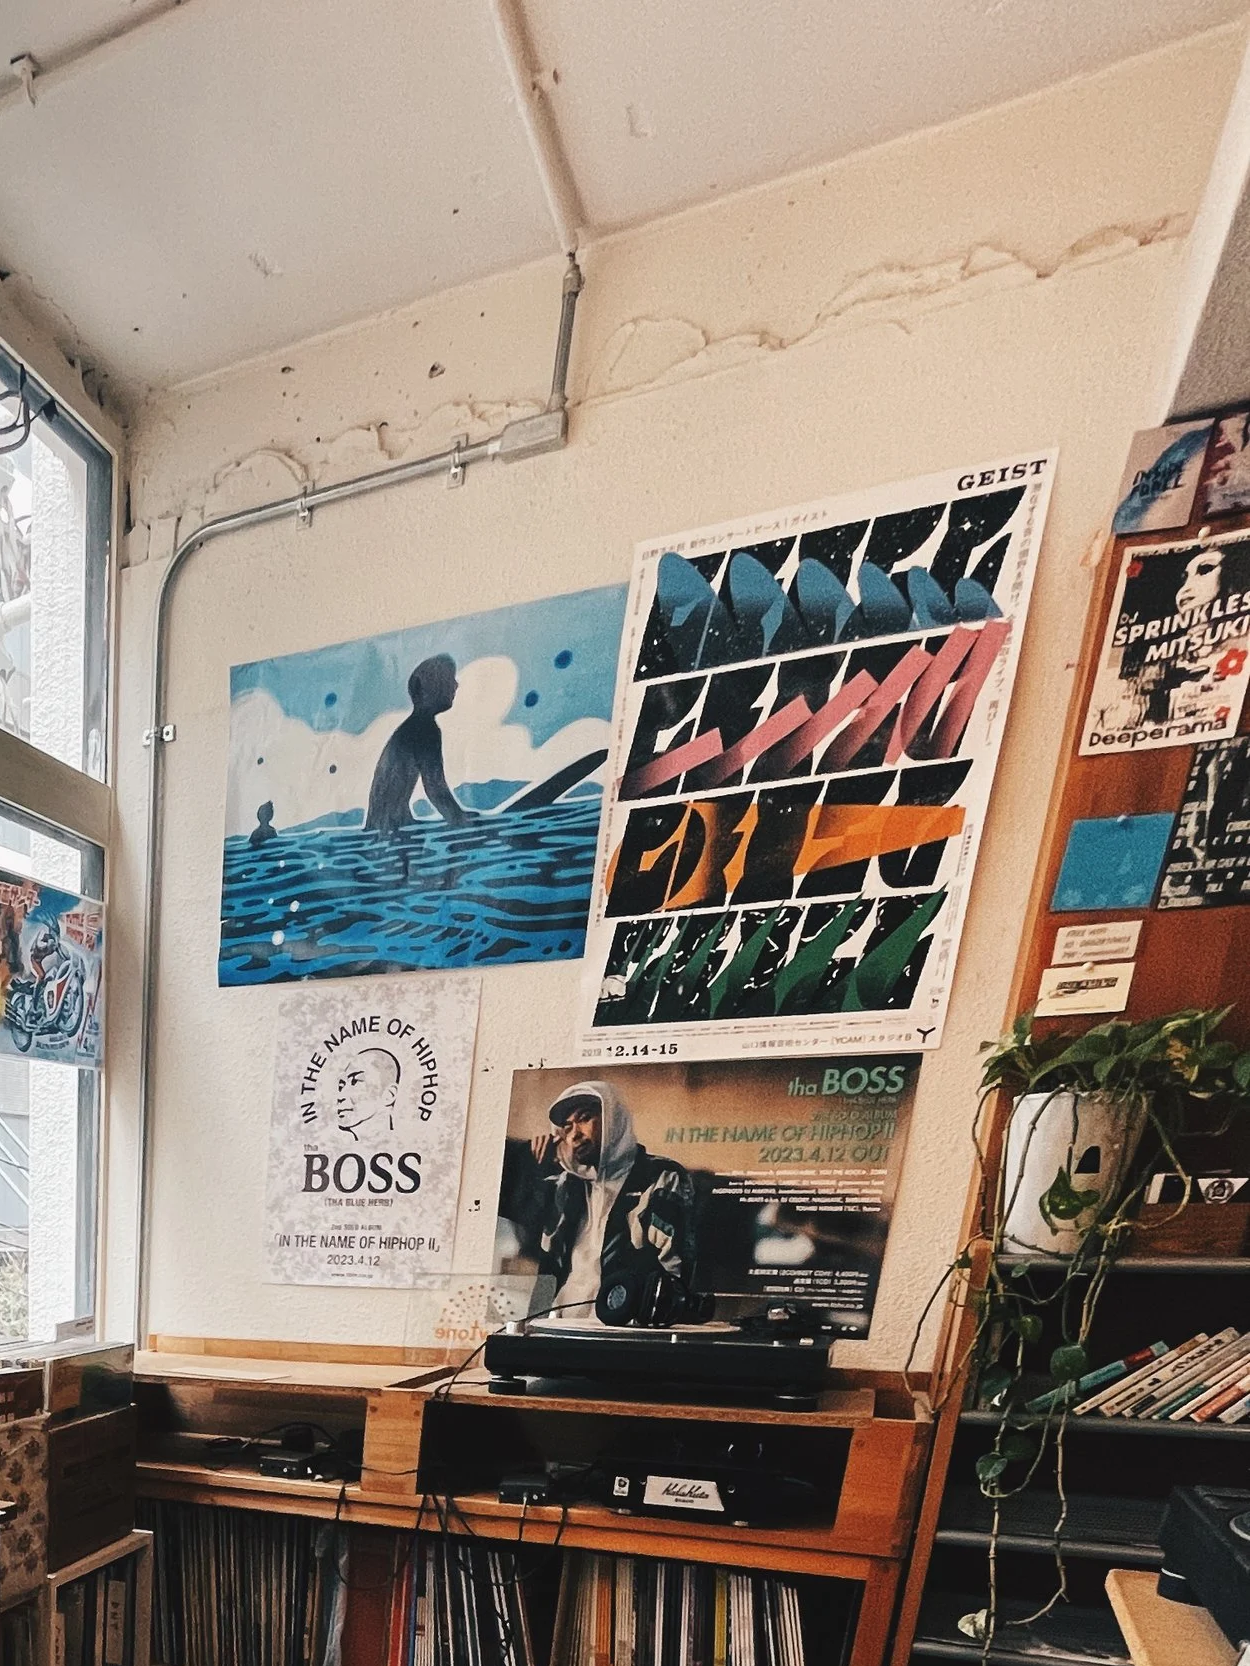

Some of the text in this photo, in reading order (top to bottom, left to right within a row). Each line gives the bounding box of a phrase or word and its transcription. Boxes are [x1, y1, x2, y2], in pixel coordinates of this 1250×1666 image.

[957, 459, 1047, 492] GEIST
[1145, 616, 1250, 663] MITSUKI
[1089, 716, 1227, 752] Deeperama
[607, 1043, 678, 1058] 12.14-15
[301, 1016, 439, 1124] IN THE NAME OF HIPHOP
[788, 1065, 906, 1096] tha BOSS
[665, 1127, 685, 1143] IN
[689, 1126, 719, 1143] THE
[723, 1125, 776, 1143] NAME
[780, 1125, 807, 1142] OF
[811, 1123, 883, 1141] HIPHOP
[758, 1146, 891, 1164] 2023.4.12 OUT
[301, 1152, 422, 1194] BOSS
[295, 1235, 316, 1248] THE
[320, 1236, 355, 1249] NAME
[359, 1236, 376, 1249] OF
[379, 1236, 425, 1251] HIPHOP
[327, 1254, 380, 1266] 2023.4.12
